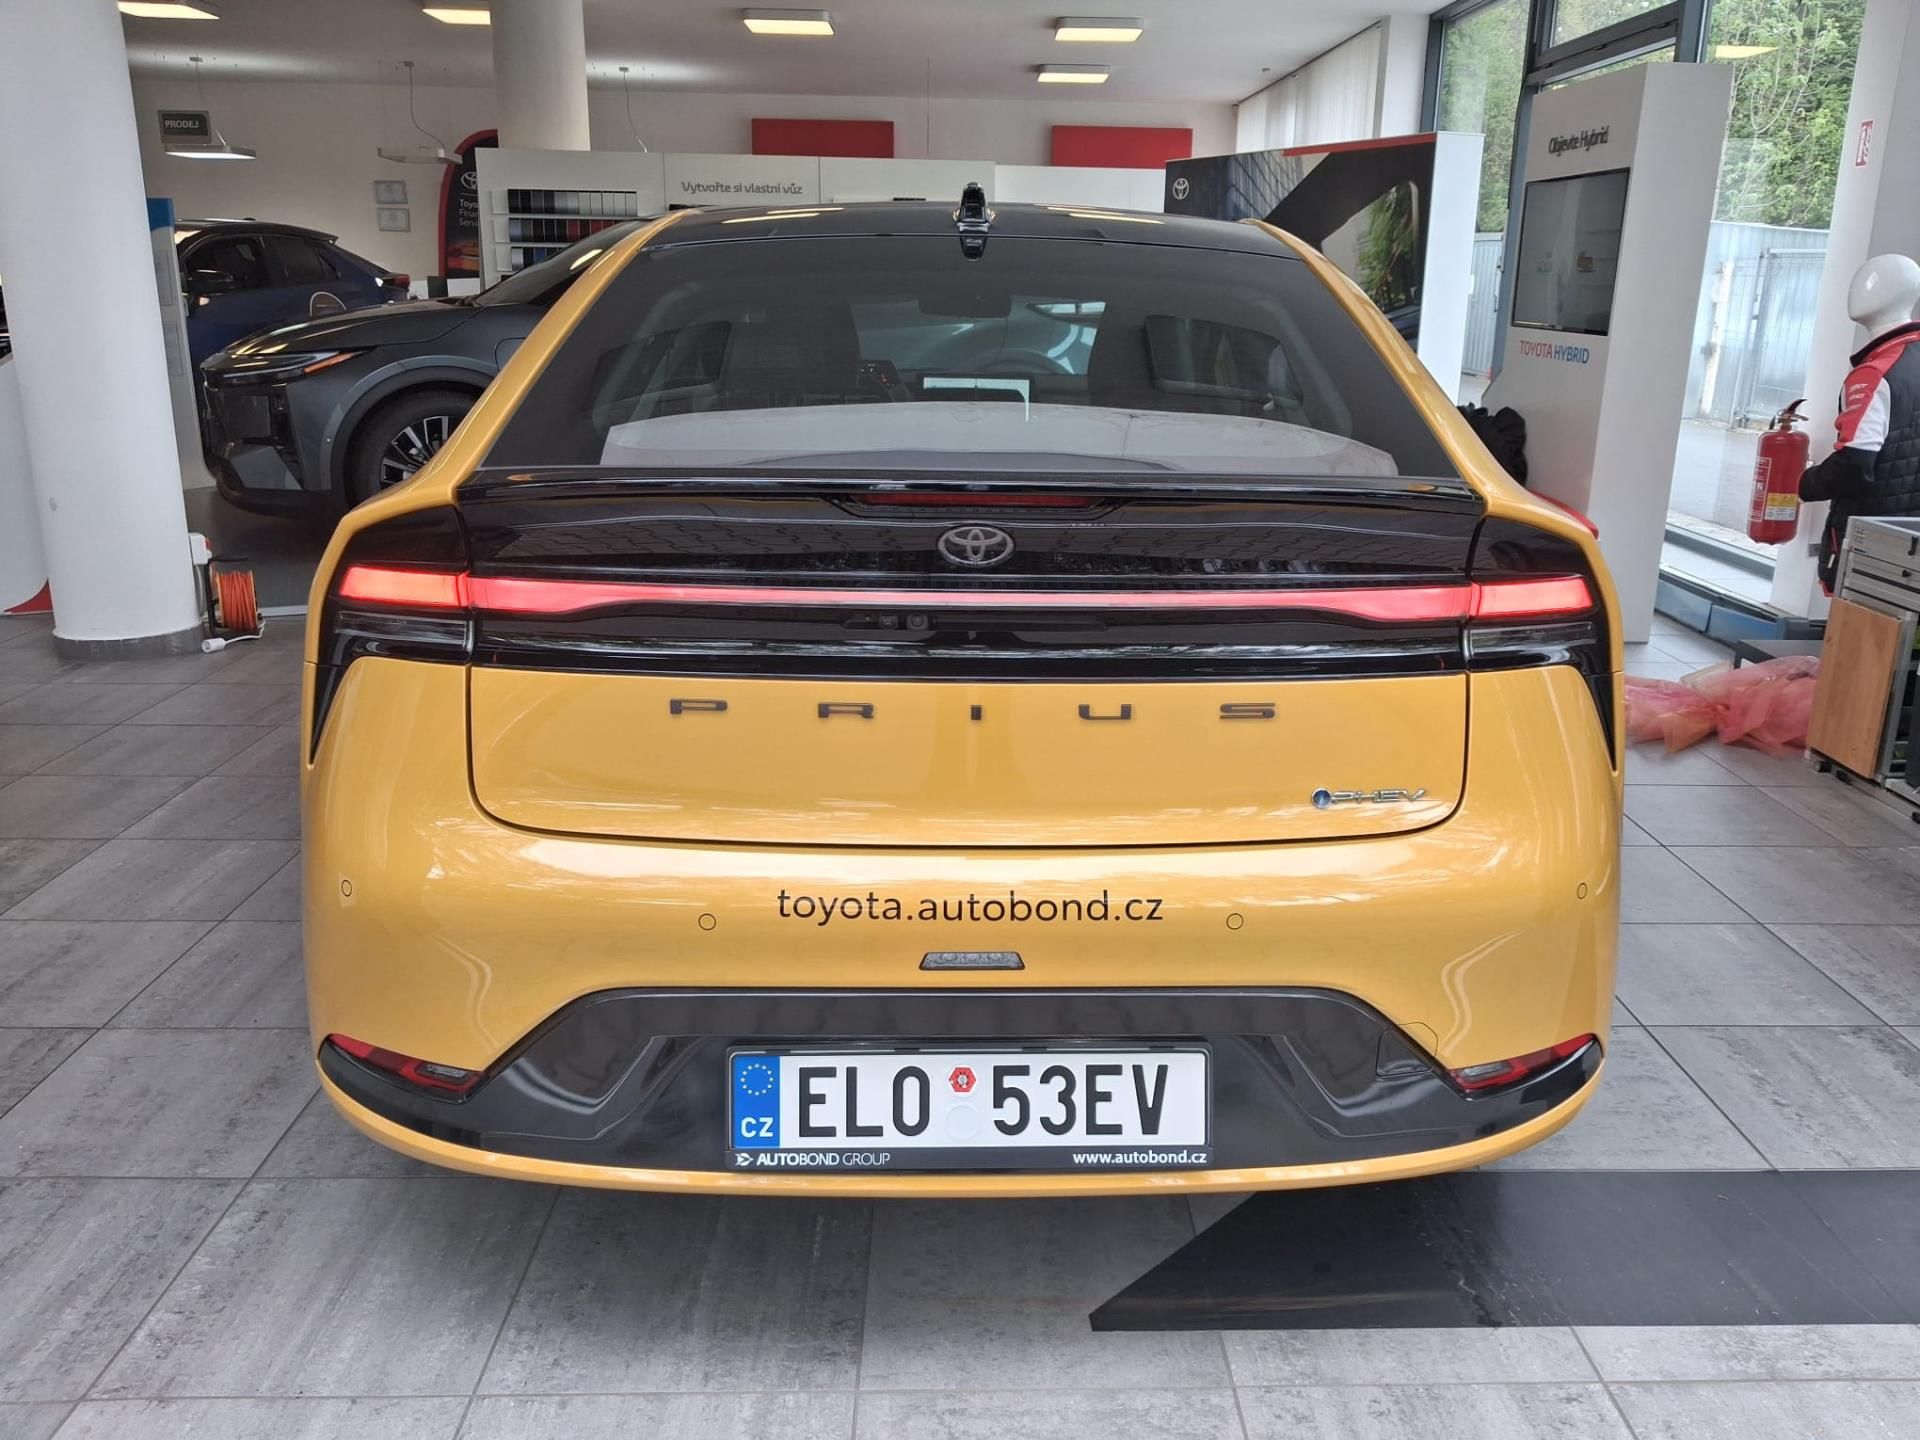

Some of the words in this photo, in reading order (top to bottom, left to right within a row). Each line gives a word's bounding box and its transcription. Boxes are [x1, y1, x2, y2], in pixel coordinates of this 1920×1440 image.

[165, 119, 199, 128] PRODEJ
[1580, 125, 1610, 151] Hybrid
[681, 181, 731, 194] Vytvořte
[733, 182, 742, 193] si
[782, 182, 803, 195] vůz
[1520, 340, 1553, 360] TOYOTA
[1554, 344, 1590, 365] HYBRID
[670, 698, 1276, 720] PRIUS
[1331, 788, 1426, 804] PHEV
[778, 889, 1164, 927] toyota.autobond.cz
[993, 1064, 1169, 1136] 53EV
[741, 1117, 774, 1138] CZ
[756, 1152, 840, 1166] AUTOBOND
[842, 1152, 891, 1166] GROUP
[1072, 1150, 1208, 1165] www.autobond.cz
